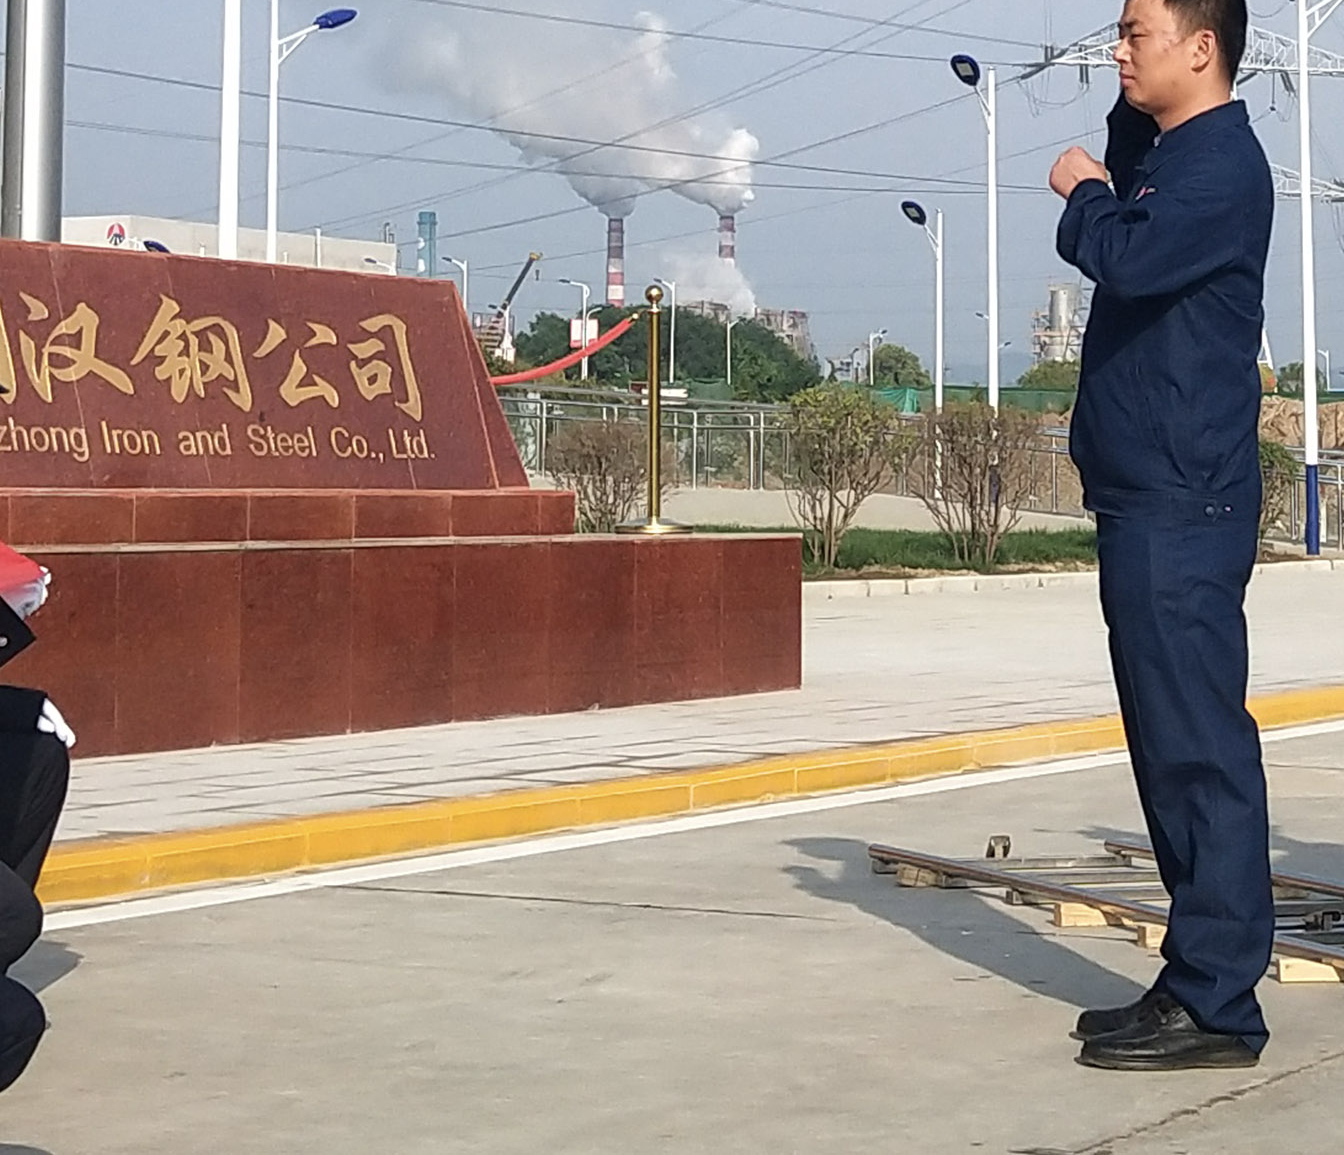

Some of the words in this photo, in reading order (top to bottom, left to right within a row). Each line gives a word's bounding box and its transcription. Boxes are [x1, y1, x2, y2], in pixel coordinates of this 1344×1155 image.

[100, 420, 162, 456] Iron
[178, 423, 233, 458] and
[248, 424, 318, 459] Steel
